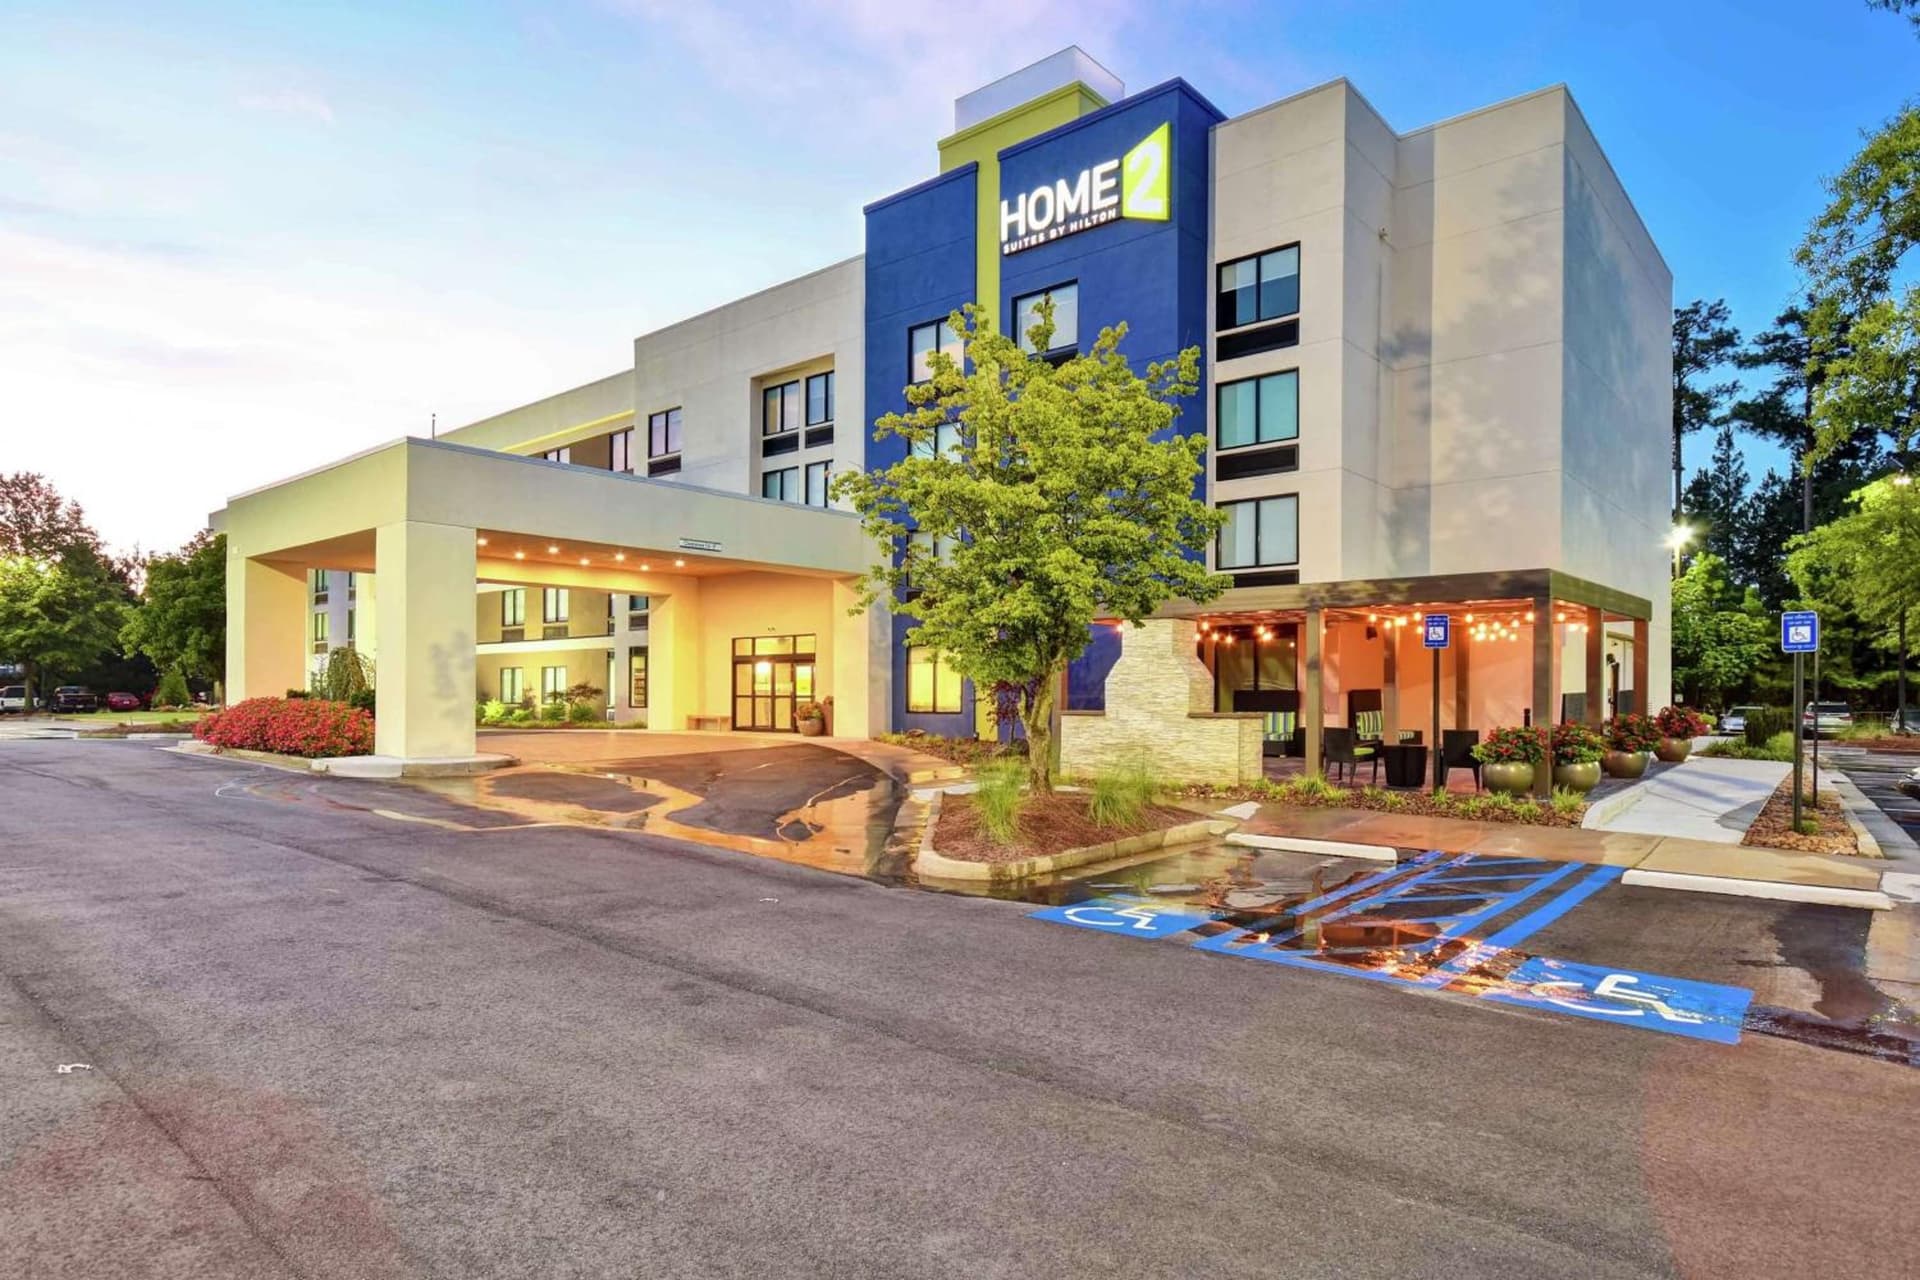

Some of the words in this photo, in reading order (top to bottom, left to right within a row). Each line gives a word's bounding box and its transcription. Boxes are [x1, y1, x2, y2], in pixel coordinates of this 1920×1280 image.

[1000, 159, 1120, 242] HOME
[1129, 140, 1163, 214] 2
[1003, 232, 1046, 255] SUITES
[1049, 225, 1066, 240] BY
[1070, 208, 1117, 231] HILTON
